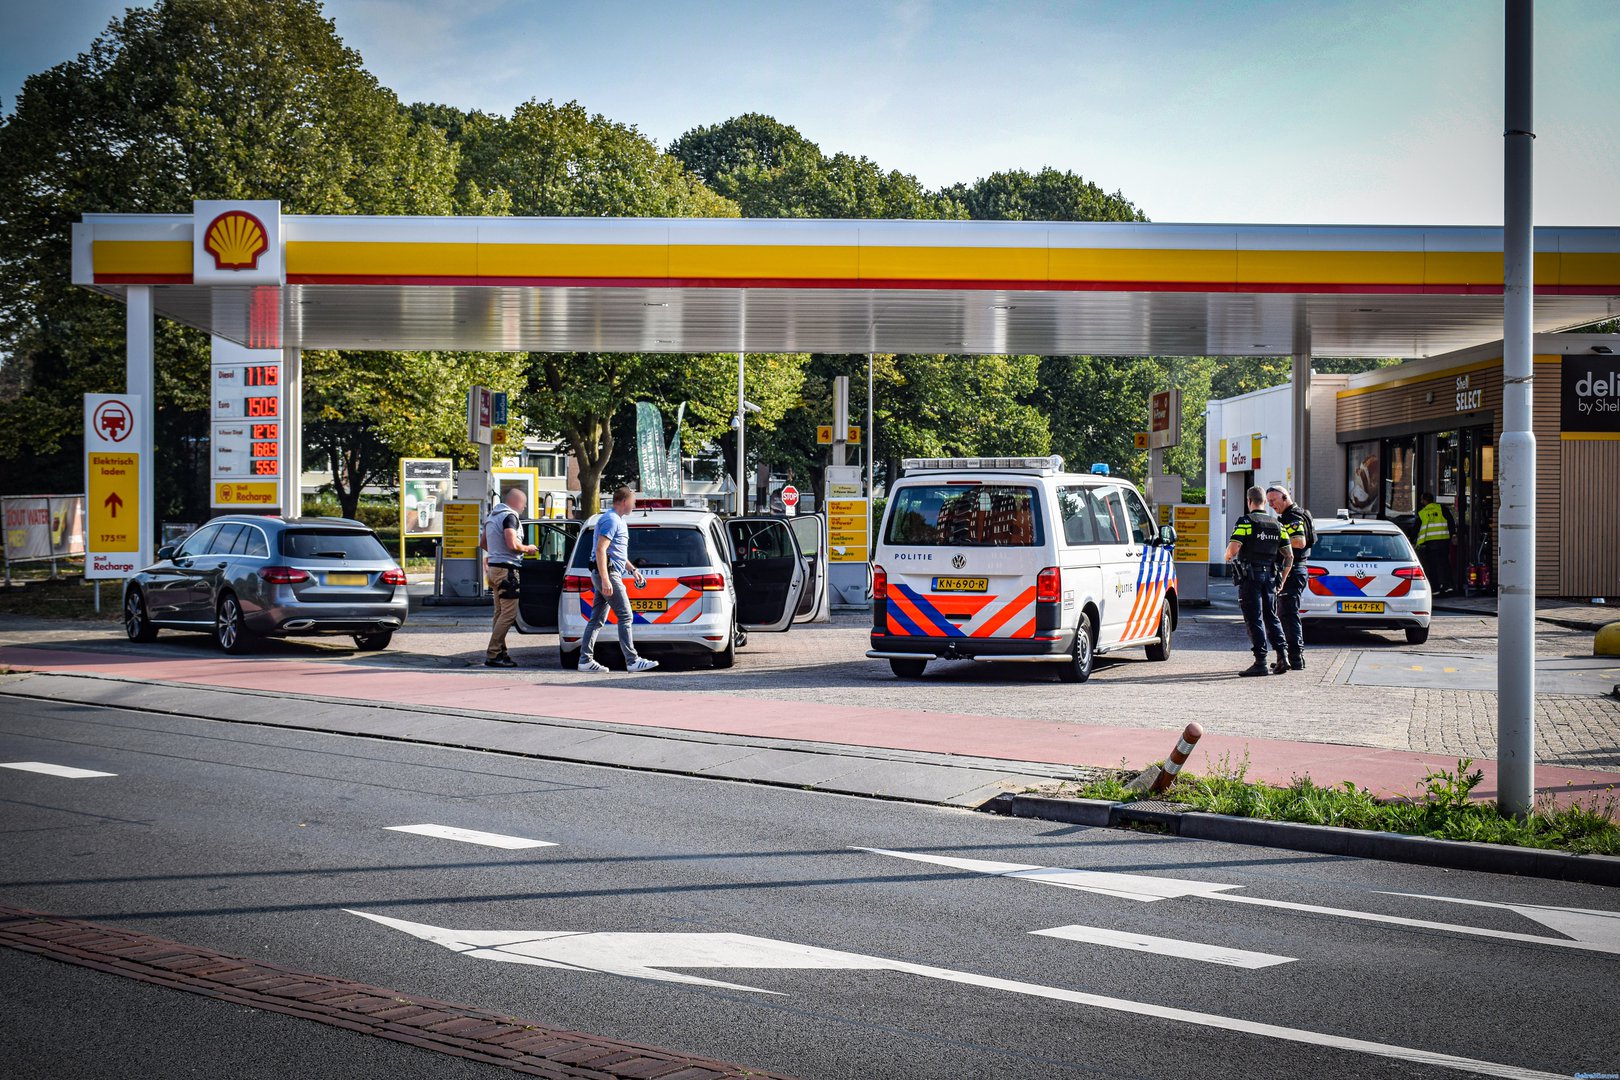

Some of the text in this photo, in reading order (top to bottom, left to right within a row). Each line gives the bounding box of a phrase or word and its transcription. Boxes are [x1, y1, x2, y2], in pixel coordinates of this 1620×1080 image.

[1456, 375, 1469, 391] Shell
[1575, 371, 1620, 397] deli
[218, 400, 230, 409] Euro
[1456, 389, 1482, 411] SELECT
[1578, 397, 1620, 416] by Shel
[496, 432, 503, 441] 5
[822, 430, 830, 440] 4
[850, 430, 857, 440] 3
[1138, 436, 1145, 445] 2
[93, 456, 134, 465] Elektrisch
[101, 467, 126, 476] laden
[236, 491, 273, 503] Recharge
[783, 492, 798, 501] STOP
[101, 534, 115, 542] 175
[894, 553, 933, 561] POLITIE
[93, 562, 134, 572] Recharge
[939, 580, 985, 589] KN-690-R
[631, 601, 663, 609] -582-B
